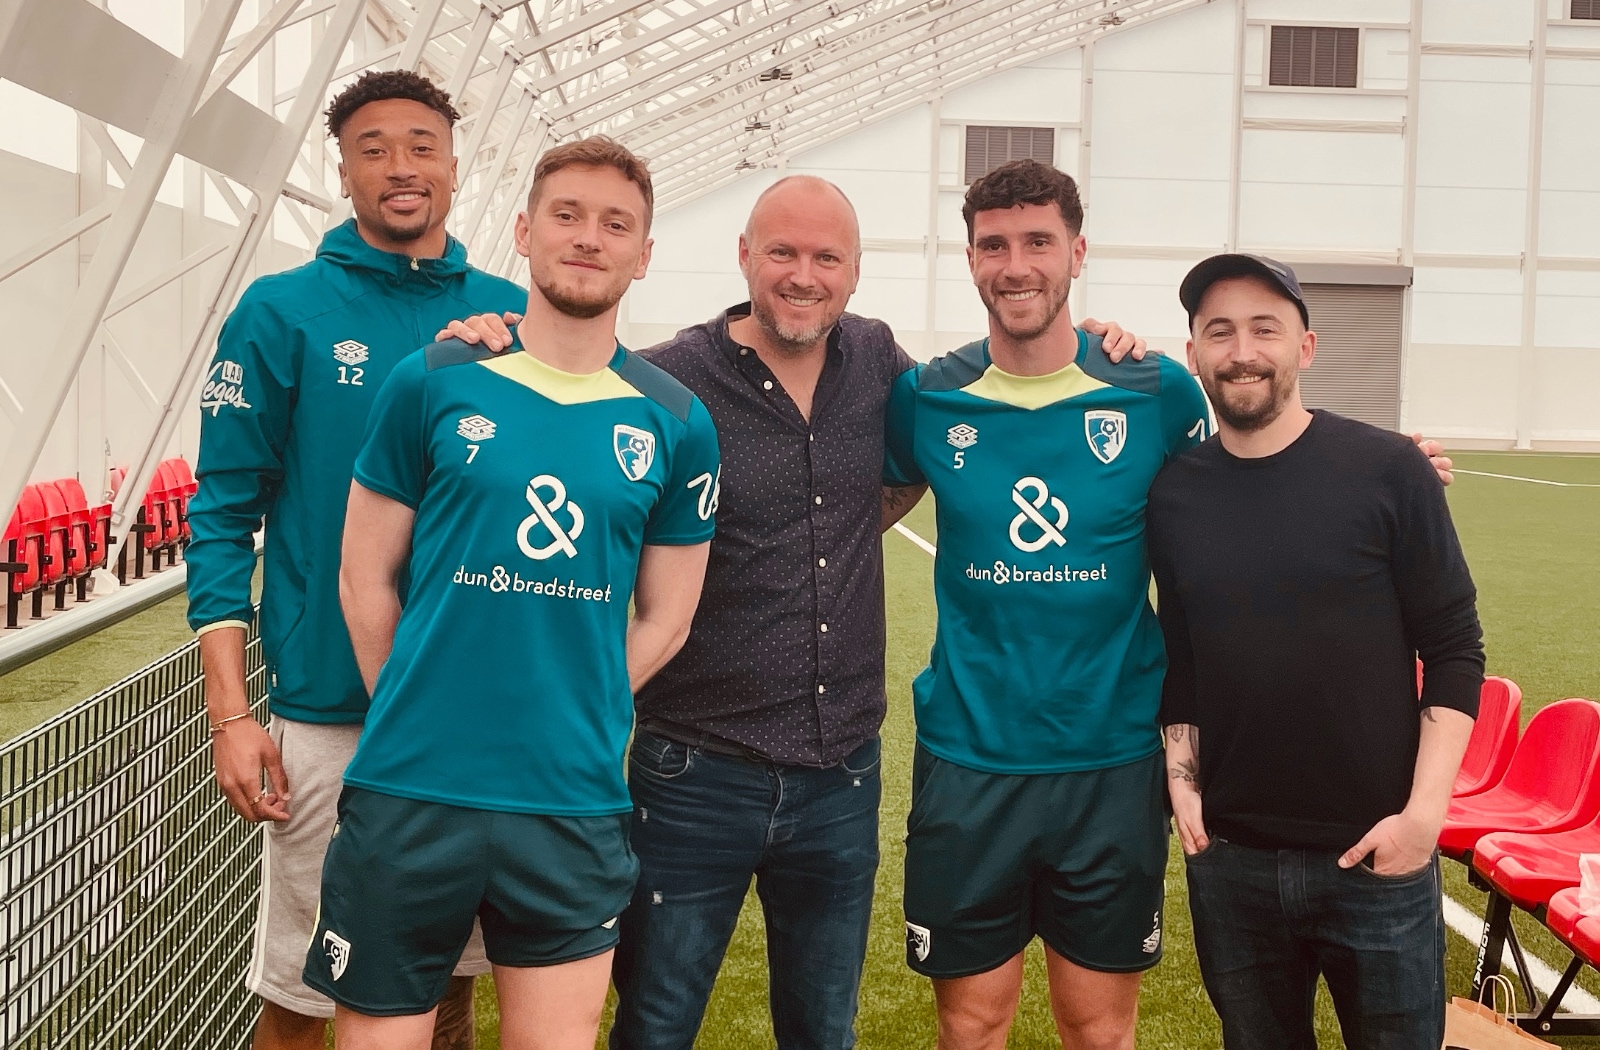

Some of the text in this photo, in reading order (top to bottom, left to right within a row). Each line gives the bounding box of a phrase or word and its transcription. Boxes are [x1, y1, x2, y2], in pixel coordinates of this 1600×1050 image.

[224, 362, 242, 382] LAS
[337, 366, 364, 386] 12
[466, 444, 480, 465] 7
[953, 451, 965, 470] 5
[516, 474, 585, 560] &
[1008, 476, 1069, 553] &
[453, 565, 612, 602] dun&bradstreet
[965, 560, 1107, 585] dun&bradstreet
[1473, 922, 1491, 985] FORZA
